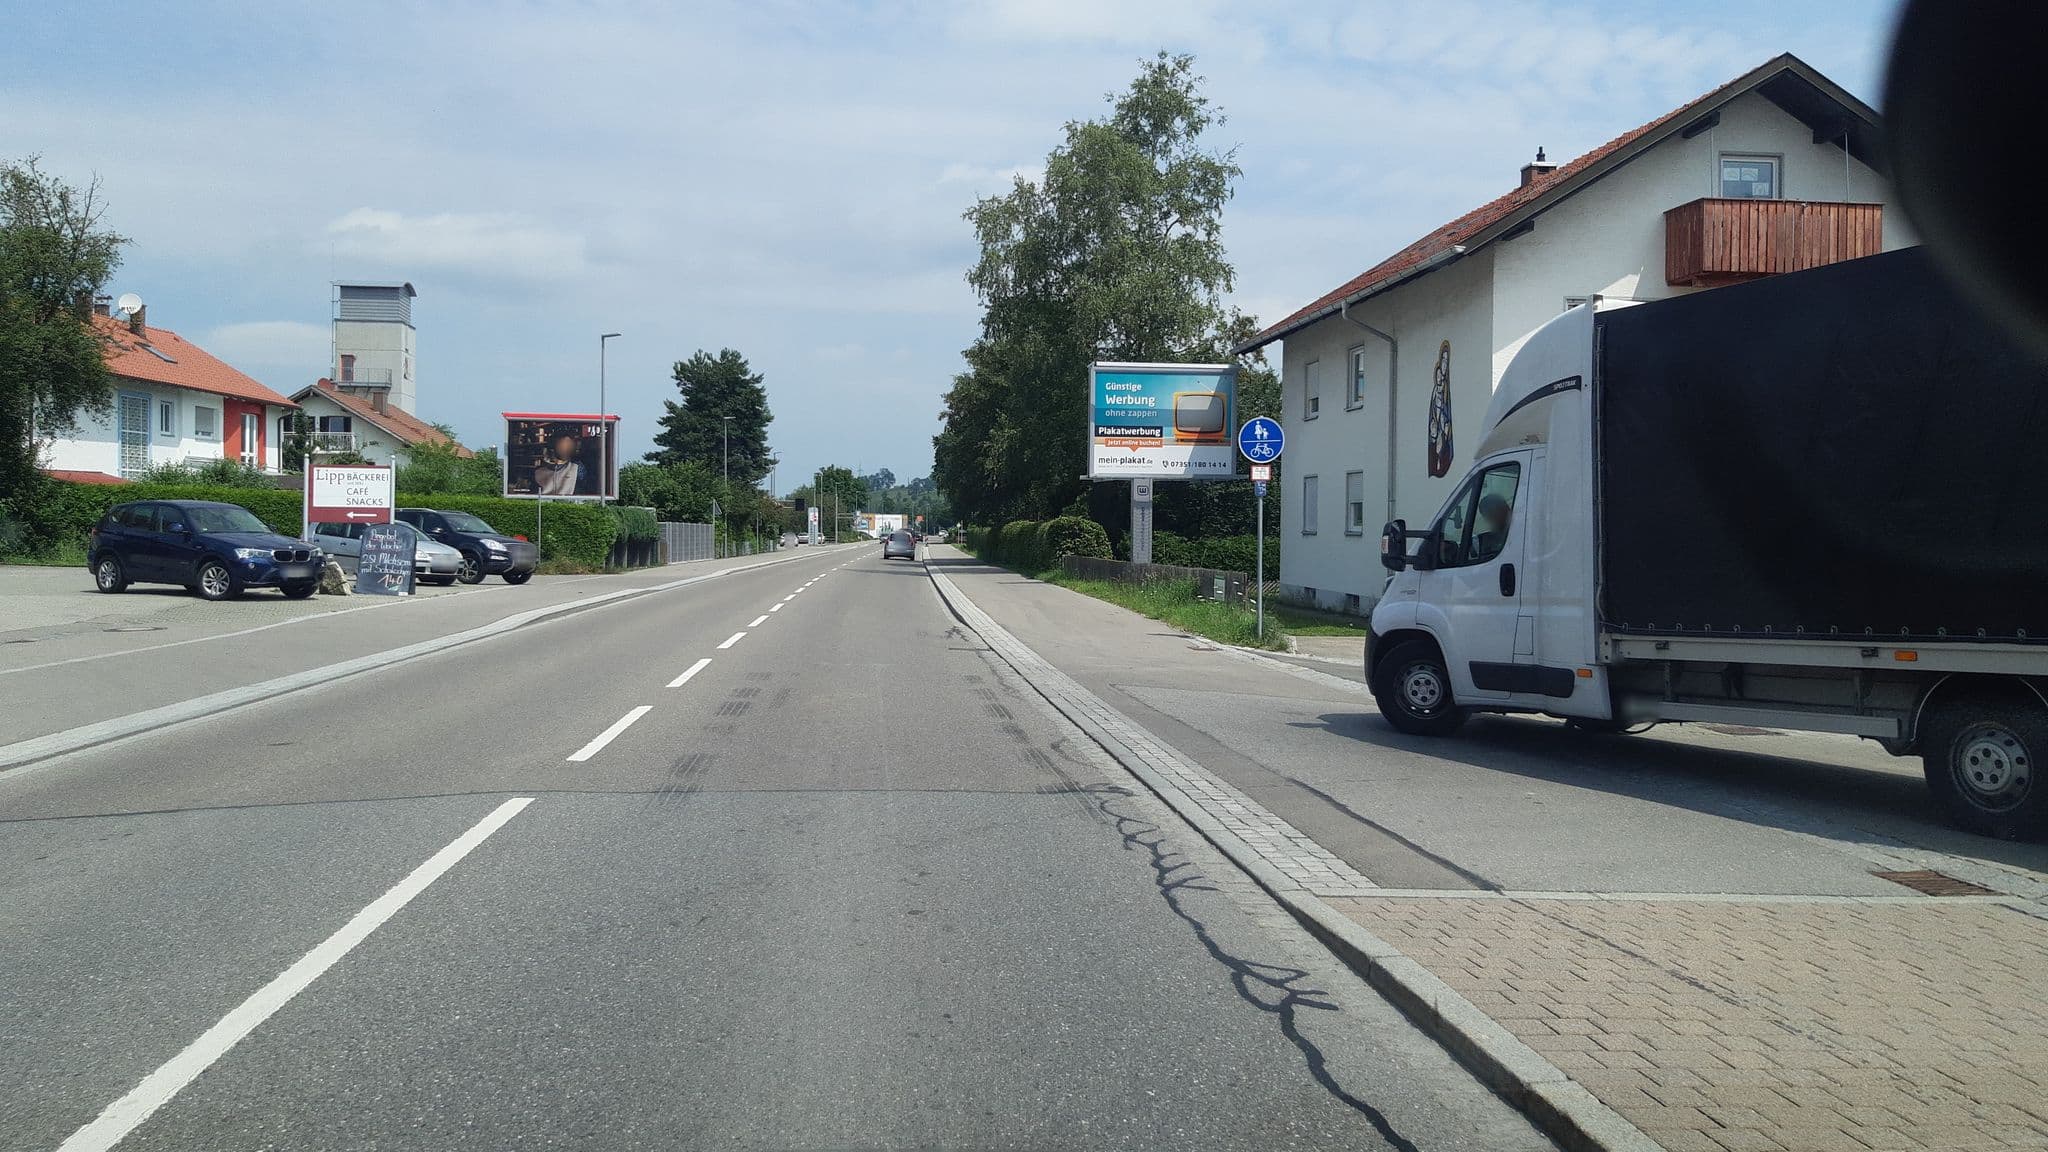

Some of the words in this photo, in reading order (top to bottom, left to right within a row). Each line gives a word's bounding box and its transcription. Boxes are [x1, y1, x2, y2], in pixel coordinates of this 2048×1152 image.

[1105, 382, 1142, 392] Günstige
[1105, 394, 1155, 407] Werbung
[1105, 409, 1126, 417] ohne
[1127, 410, 1157, 418] zappen
[1098, 426, 1161, 437] Plakatwerbung
[316, 469, 345, 485] Lipp
[347, 472, 389, 482] BÄCKEREI
[346, 487, 369, 496] CAFÉ
[346, 497, 384, 506] SNACKS
